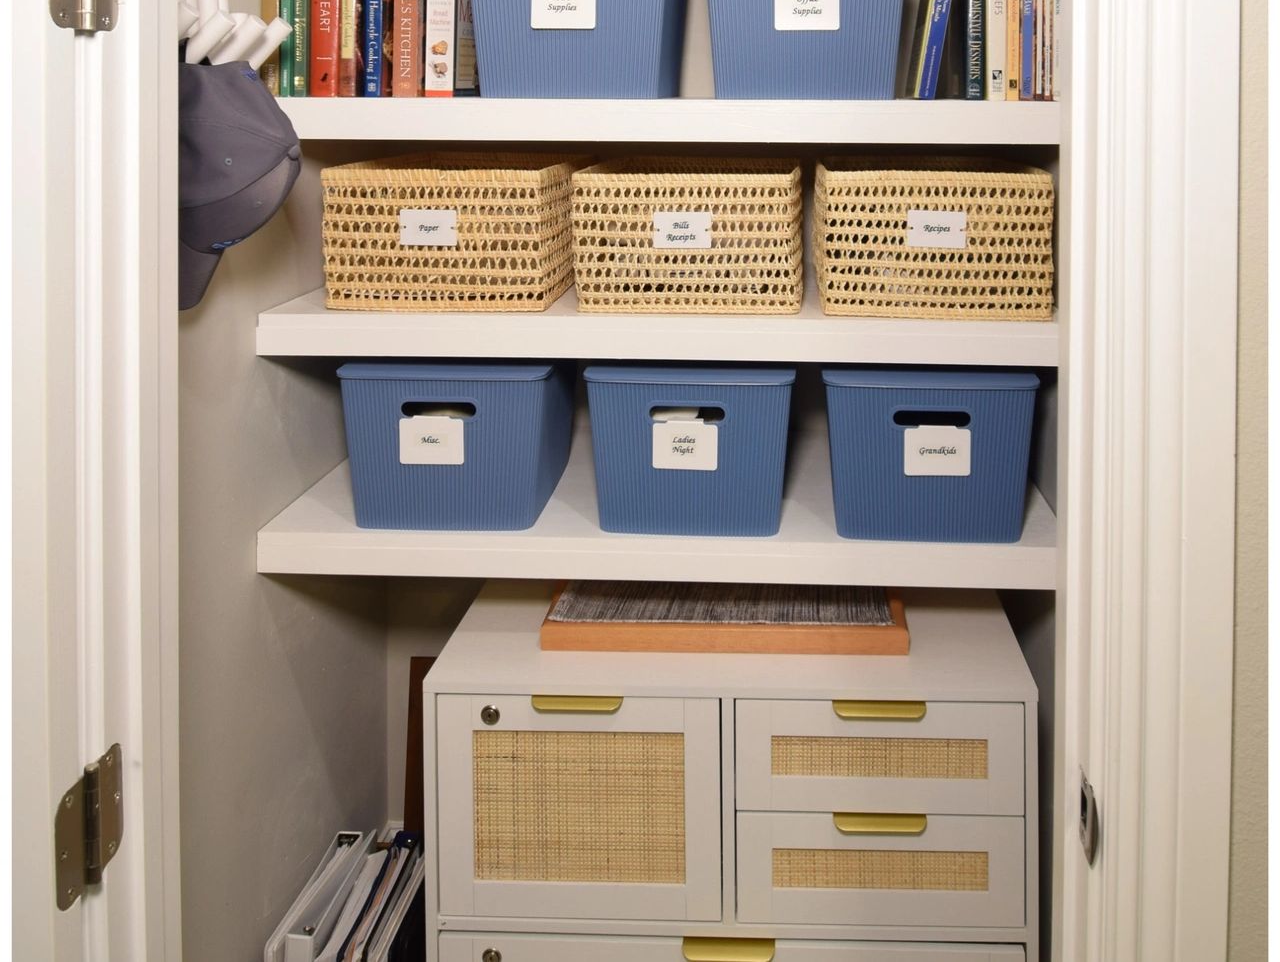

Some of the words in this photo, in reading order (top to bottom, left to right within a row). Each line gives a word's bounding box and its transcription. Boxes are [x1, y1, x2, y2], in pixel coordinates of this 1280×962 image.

[547, 3, 577, 14] Supplies
[792, 6, 822, 17] Supplies
[933, 4, 942, 23] Meals
[368, 0, 379, 40] Homestyle
[400, 17, 412, 79] KITCHEN
[366, 41, 378, 74] Cooking
[969, 40, 982, 80] DESSERTS
[418, 224, 440, 234] Paper
[672, 221, 690, 230] Bills
[923, 224, 951, 234] Recipes
[665, 233, 696, 243] Receipts
[420, 436, 441, 444] Misc.
[672, 435, 696, 444] Ladies
[672, 445, 695, 455] Night
[919, 446, 957, 456] Grandkids
